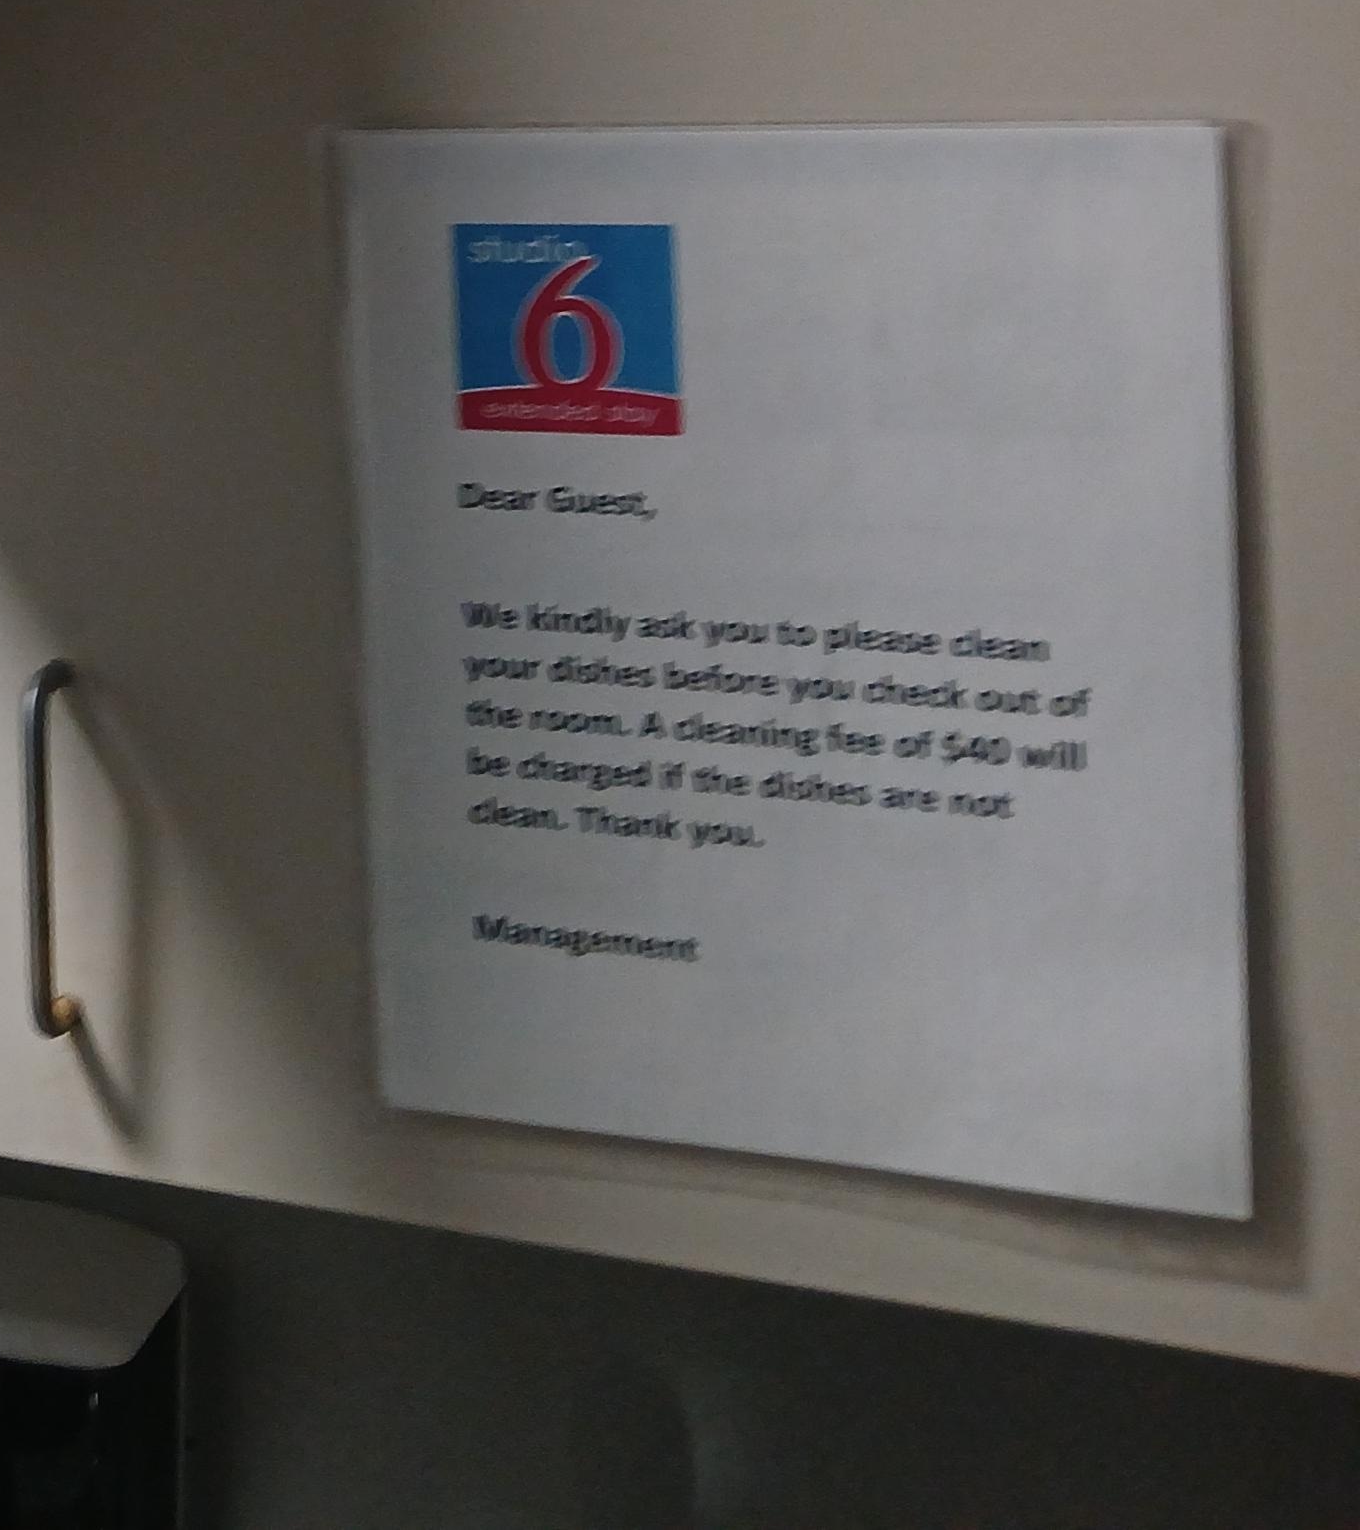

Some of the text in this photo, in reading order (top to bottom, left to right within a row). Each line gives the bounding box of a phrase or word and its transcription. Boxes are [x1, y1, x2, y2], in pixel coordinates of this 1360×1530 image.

[516, 254, 625, 389] 6
[457, 482, 659, 520] Dear Guest,
[461, 601, 1051, 662] We kindly ask you to please clean
[462, 655, 1093, 718] your dishes before you check out of
[464, 698, 1088, 771] the room. A cleaning fee of $40 will
[464, 746, 1015, 820] be charged if the dishes are not
[466, 796, 767, 849] clean. Thank you.
[471, 914, 703, 963] Management
